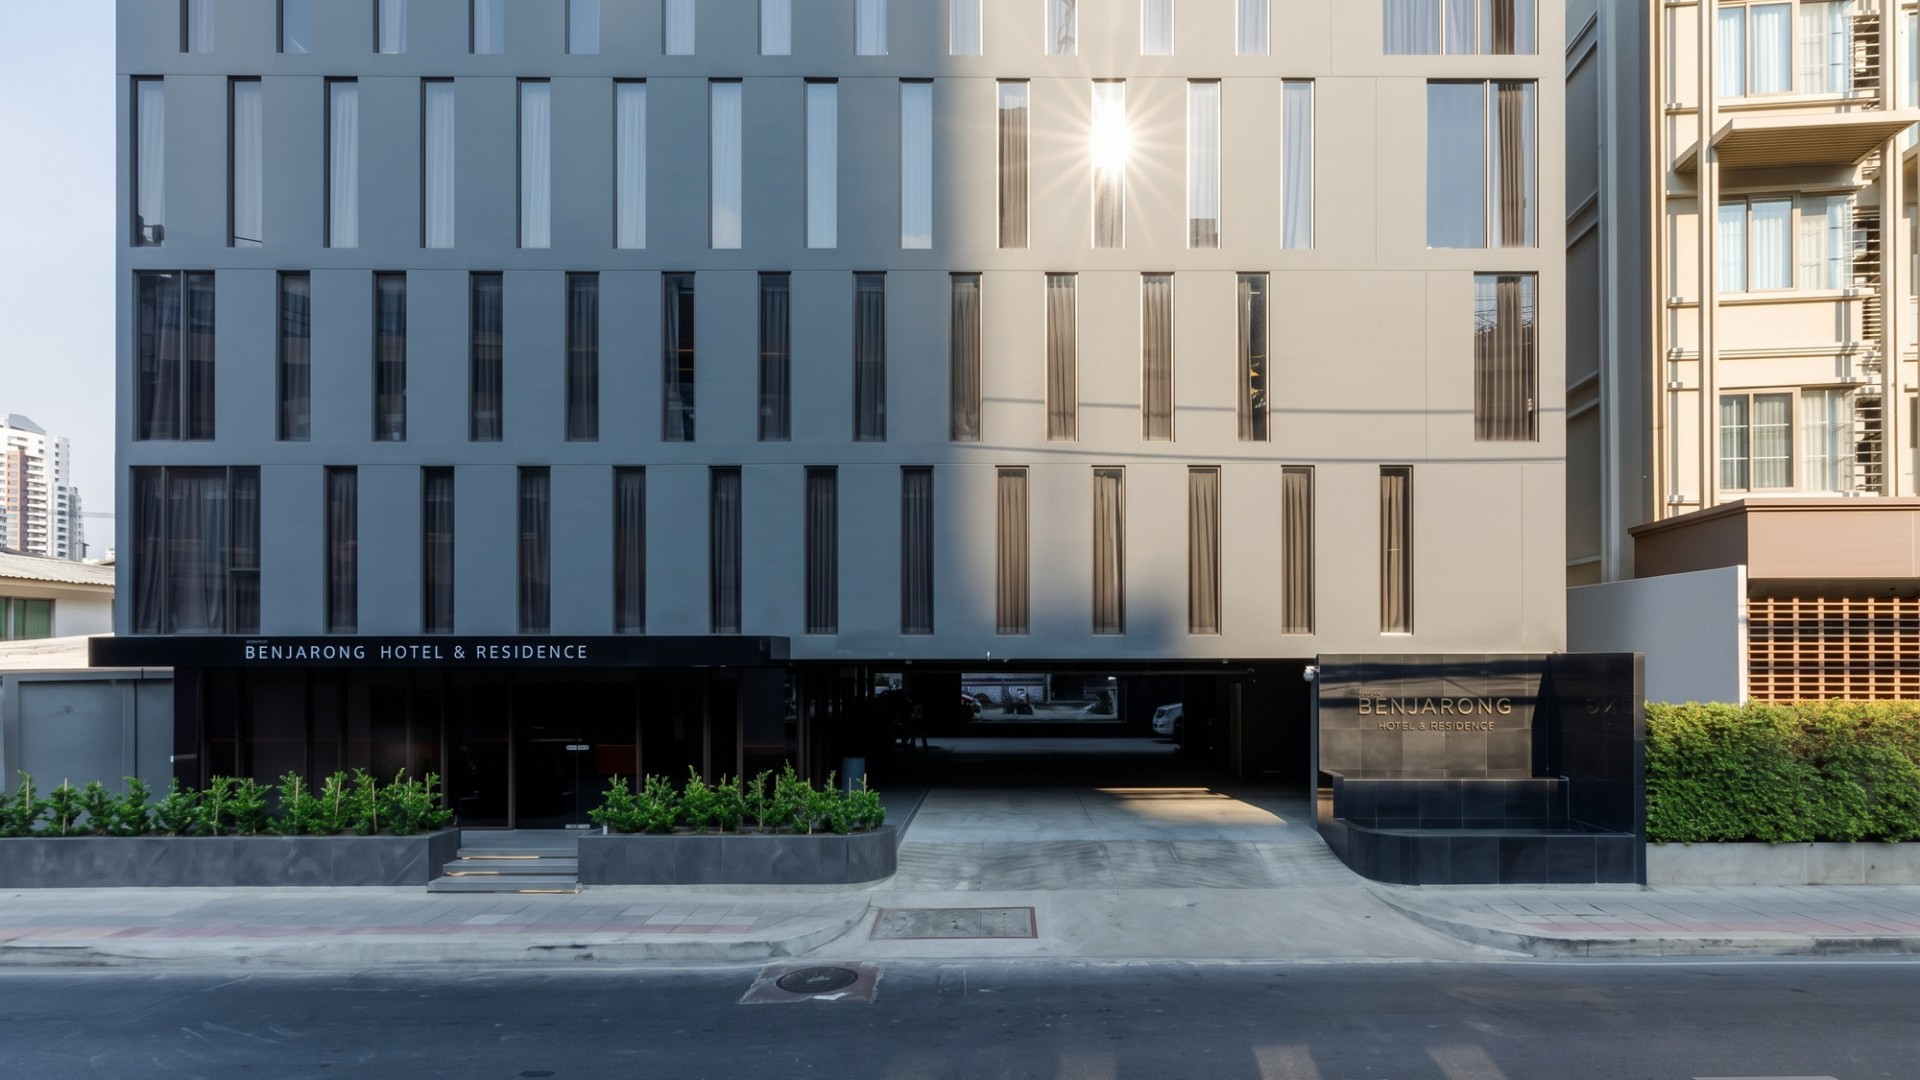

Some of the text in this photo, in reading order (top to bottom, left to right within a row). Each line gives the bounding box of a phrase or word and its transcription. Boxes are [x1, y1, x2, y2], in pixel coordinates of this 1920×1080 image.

[245, 645, 587, 659] BENJARONG HOTEL & RESIDENCE
[1358, 697, 1512, 716] BENJARONG
[1378, 721, 1495, 731] HOTEL & RESIDENCE
